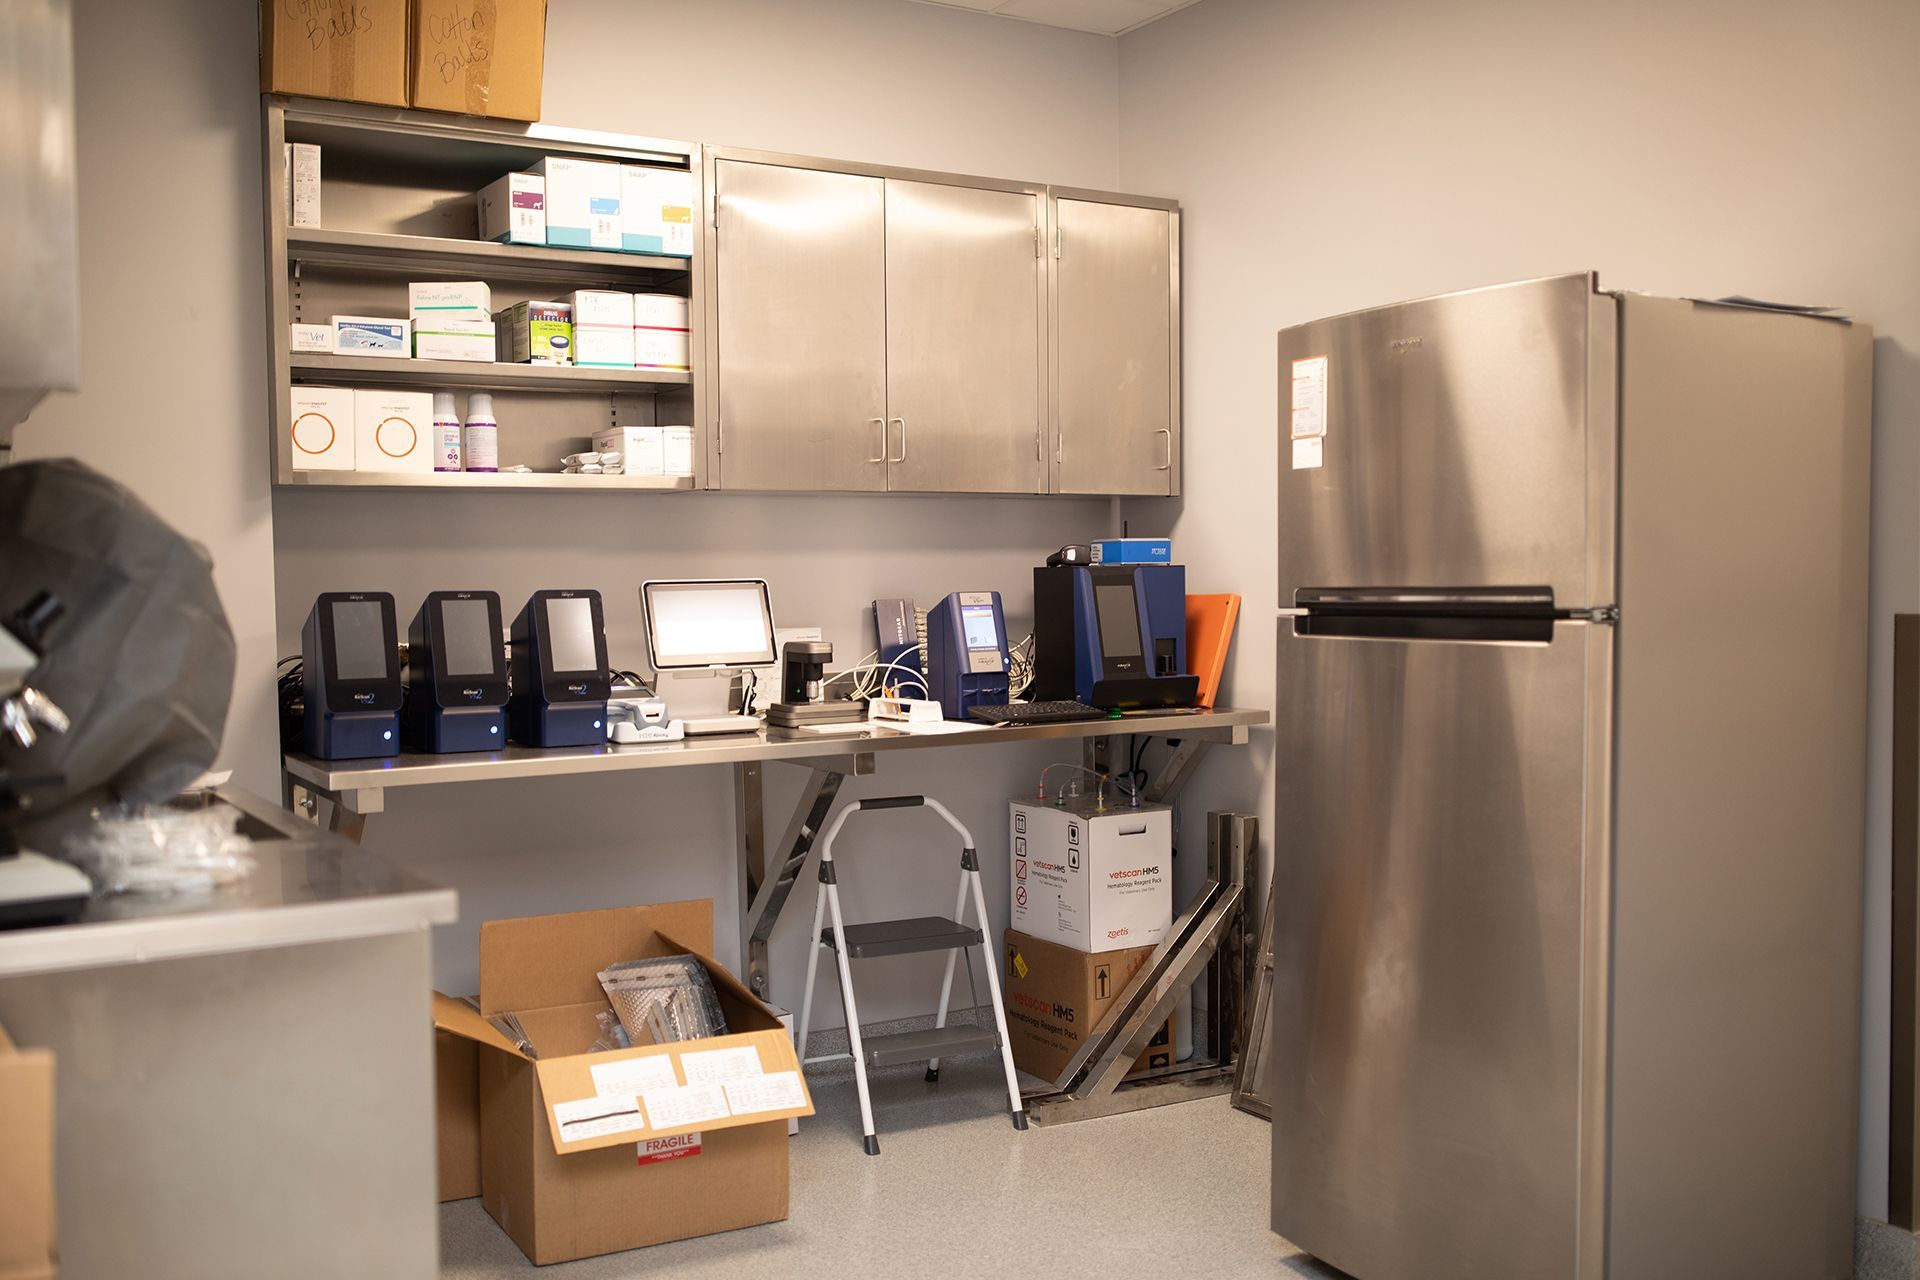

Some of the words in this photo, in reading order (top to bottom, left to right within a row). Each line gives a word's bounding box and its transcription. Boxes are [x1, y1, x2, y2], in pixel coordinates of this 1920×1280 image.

[306, 5, 373, 51] Balls
[428, 4, 485, 44] Cotton
[433, 40, 488, 84] Balls
[533, 315, 568, 323] DETECTOR
[310, 331, 324, 341] Vet
[1107, 881, 1133, 889] Hematology
[1134, 879, 1151, 887] Reagent
[1107, 927, 1129, 939] zoetis
[1009, 1010, 1040, 1028] Hematology
[1040, 1020, 1064, 1037] Reagent
[1064, 1028, 1078, 1041] Pack
[646, 1134, 693, 1152] FRAGILE
